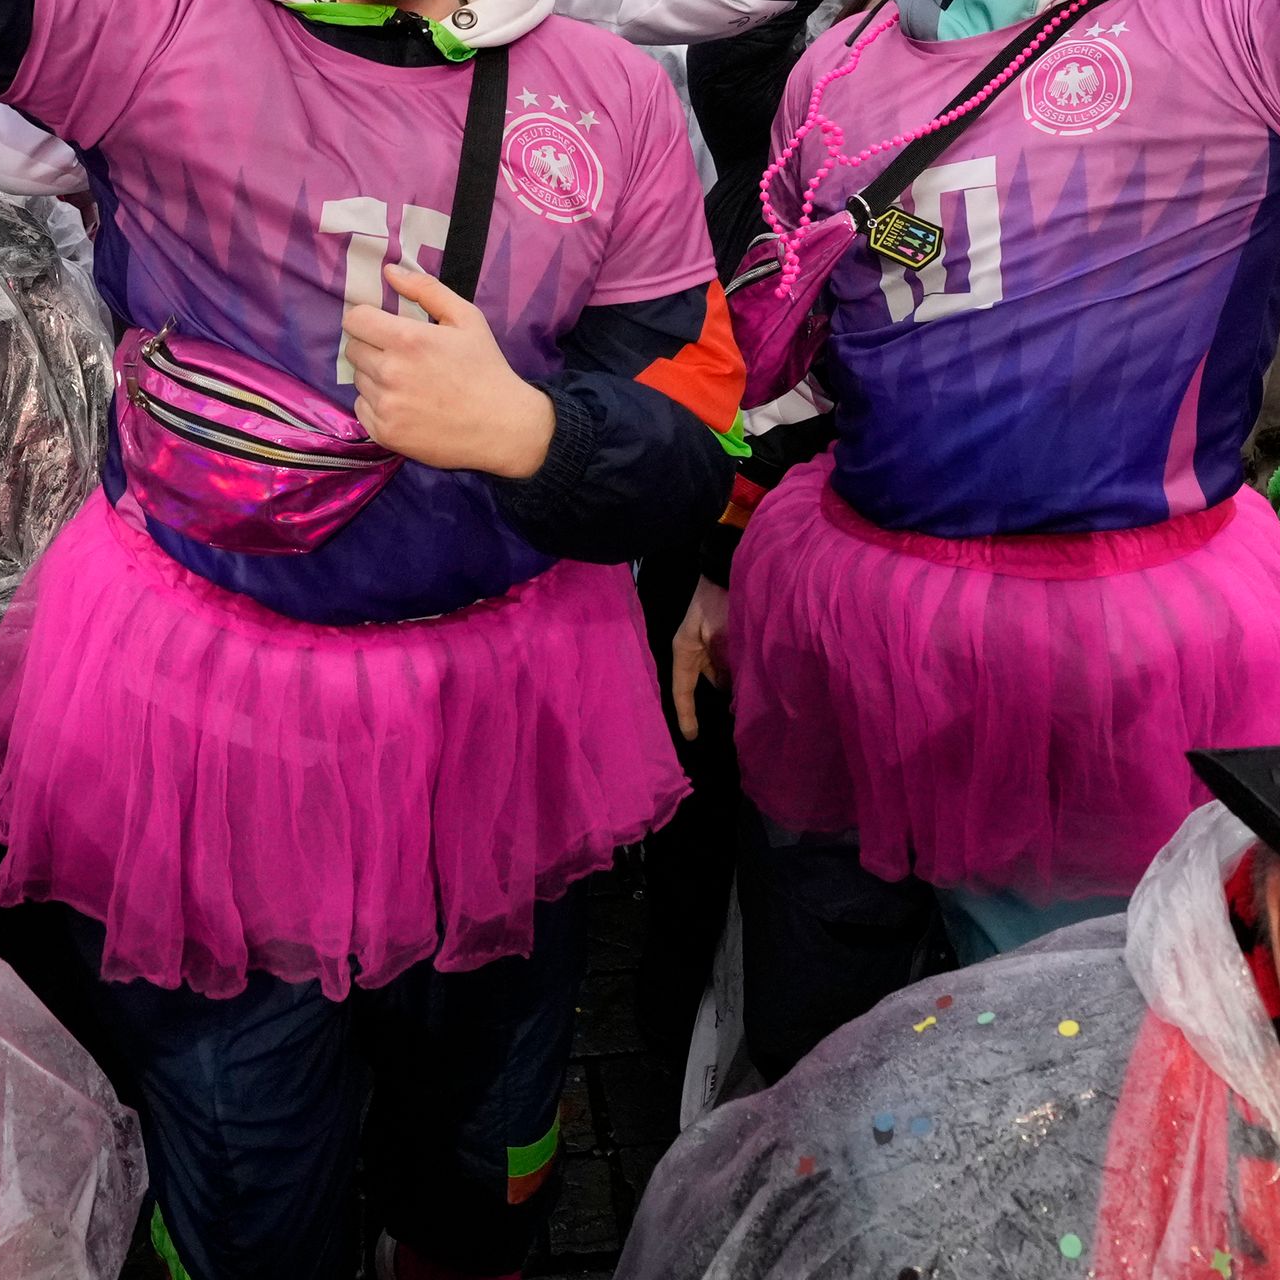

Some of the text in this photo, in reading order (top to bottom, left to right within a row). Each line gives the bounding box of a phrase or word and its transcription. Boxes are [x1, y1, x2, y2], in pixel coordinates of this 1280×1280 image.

[1041, 46, 1103, 71] DEUTSCHER
[517, 127, 577, 154] DEUTSCHER
[883, 219, 905, 247] SALITOS
